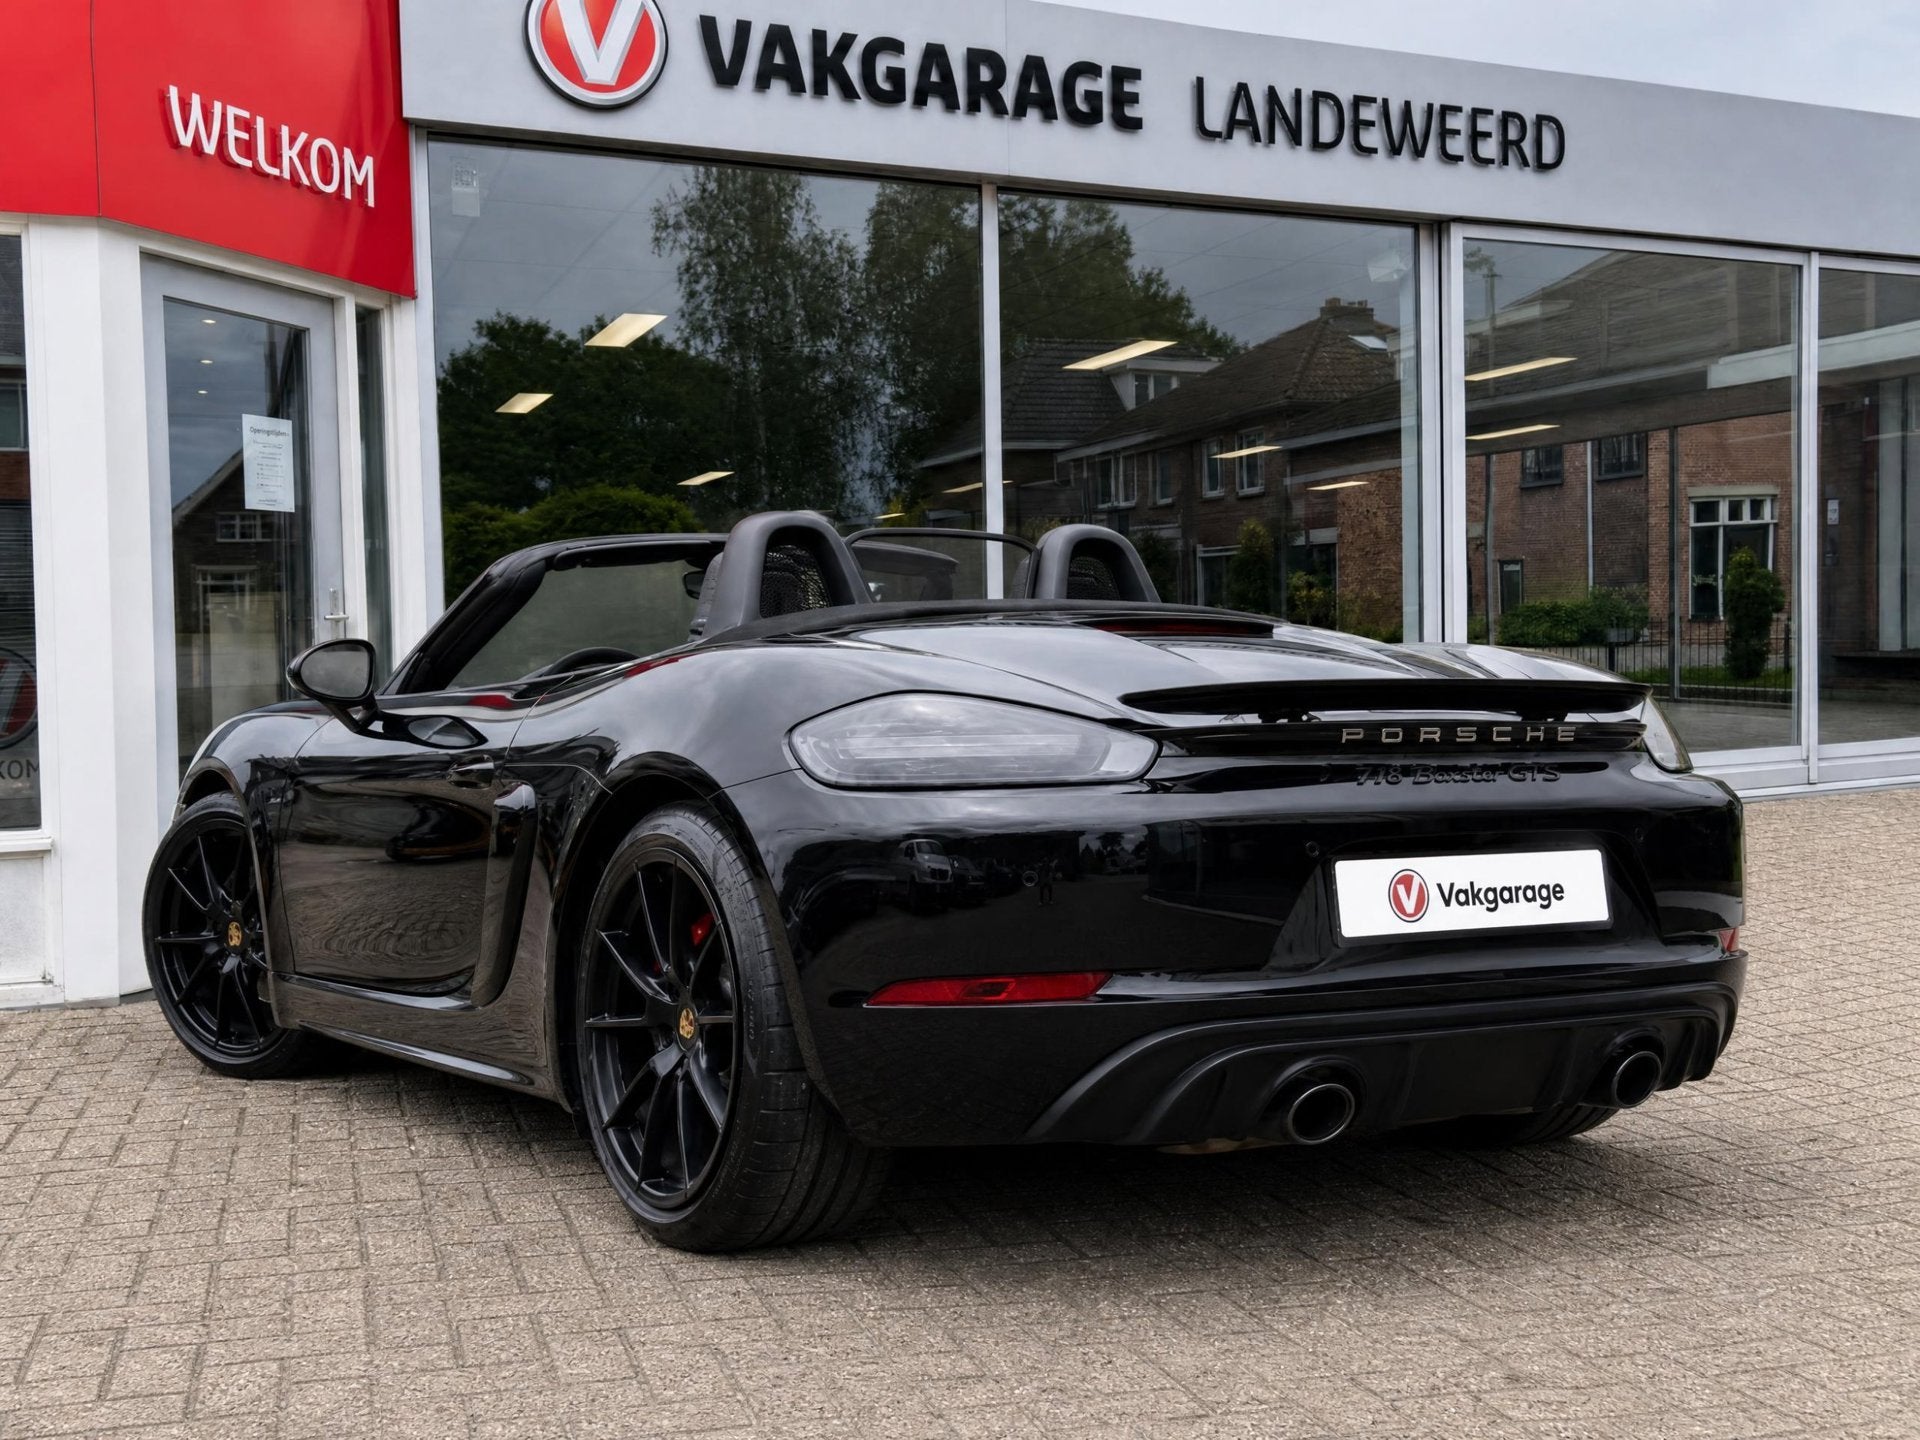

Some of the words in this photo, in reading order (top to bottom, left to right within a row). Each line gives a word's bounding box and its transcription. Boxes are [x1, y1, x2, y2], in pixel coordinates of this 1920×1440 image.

[698, 14, 1144, 131] VAKGARAGE
[1194, 75, 1566, 171] LANDEWEERD
[168, 84, 375, 208] WELKOM
[1340, 726, 1577, 744] PORSCHE
[1355, 765, 1404, 786] 718
[1411, 765, 1504, 785] Boxster
[1507, 763, 1561, 783] GTS
[1436, 881, 1565, 913] Vakgarage
